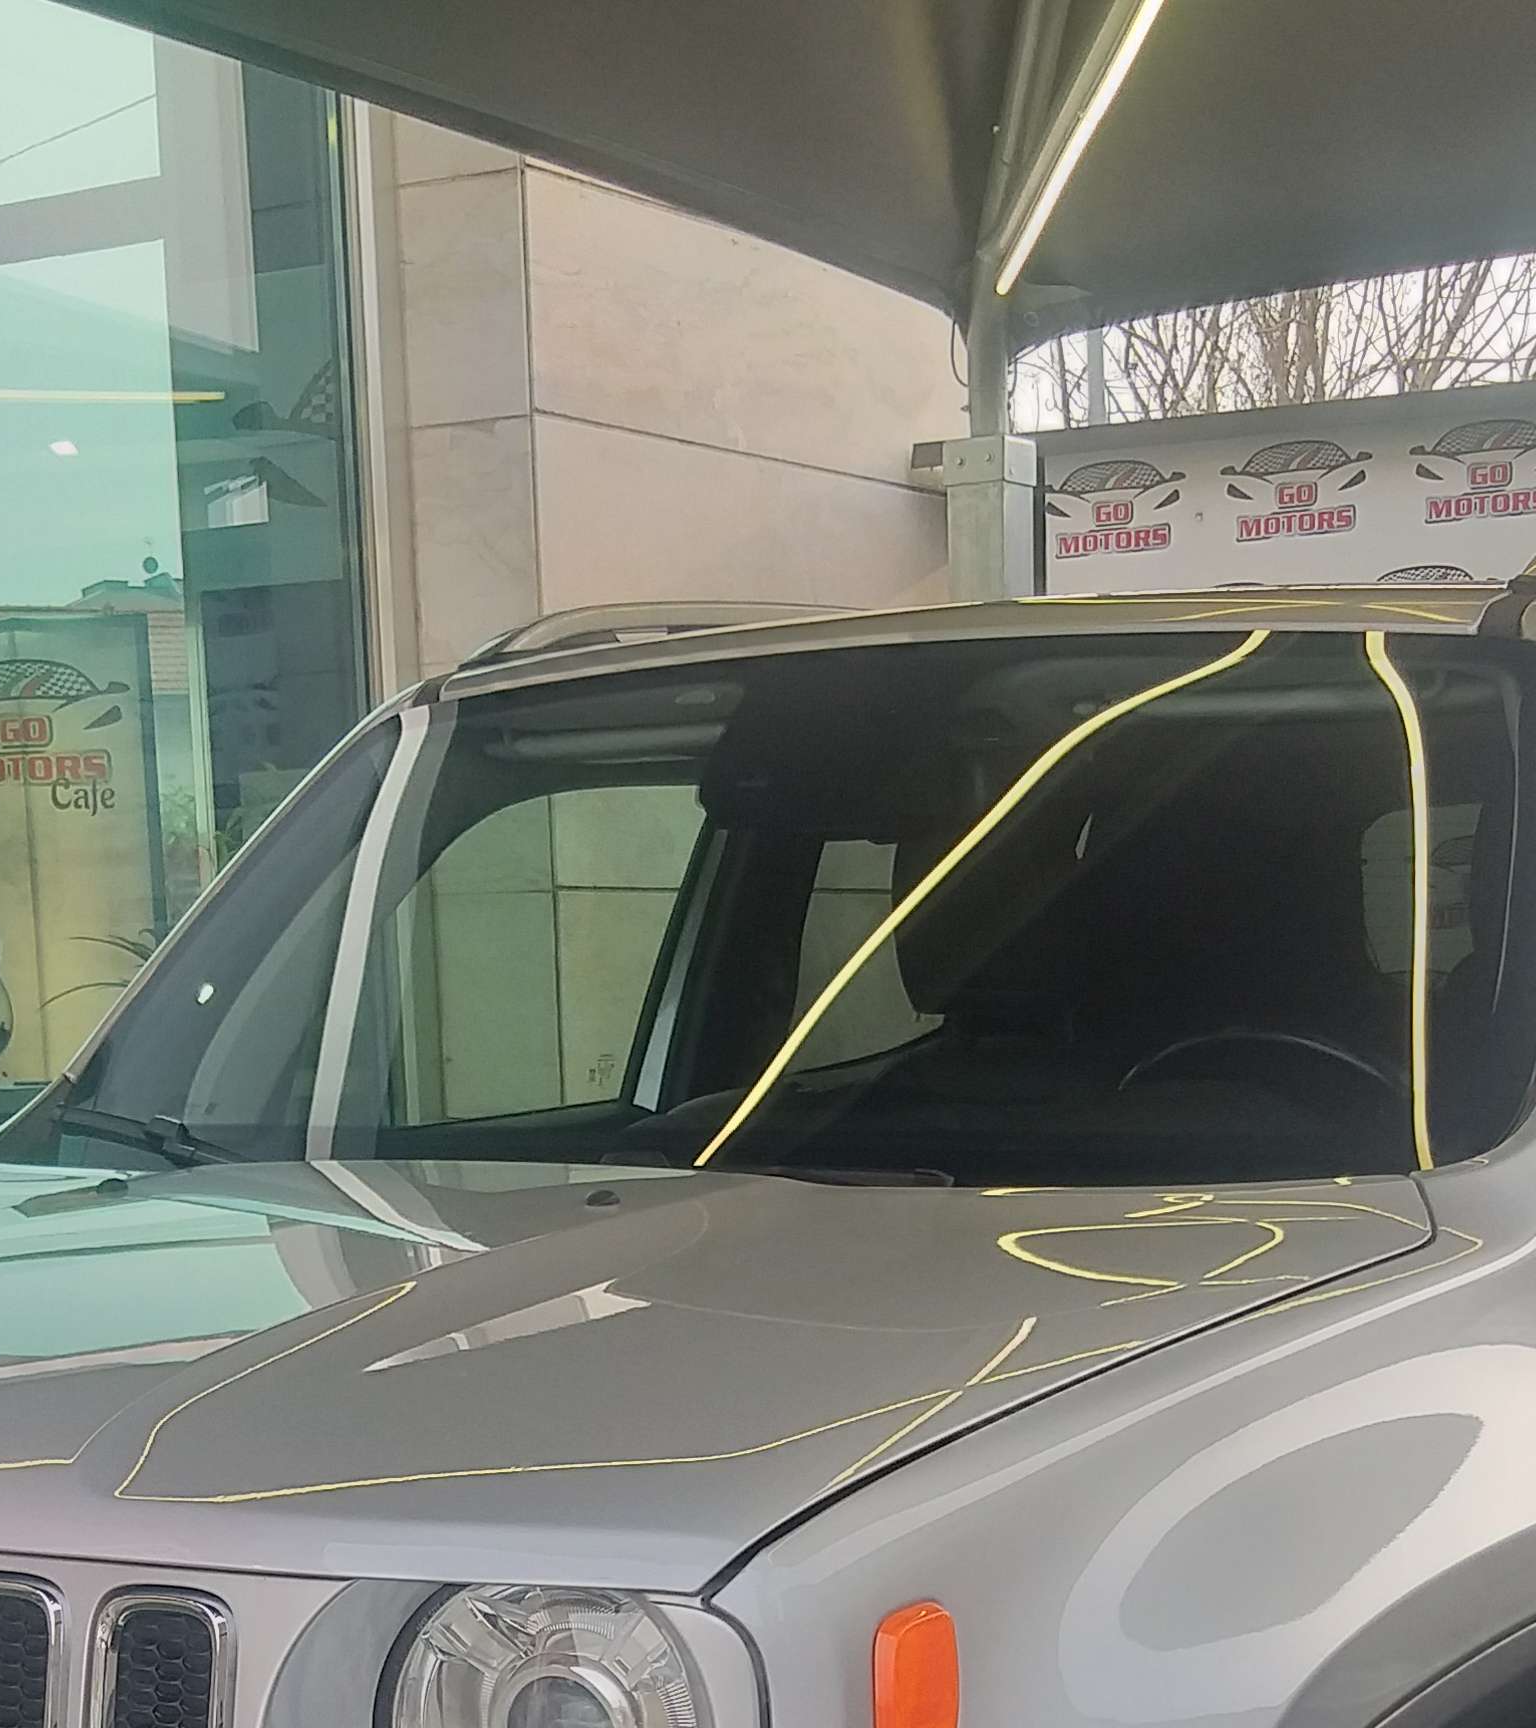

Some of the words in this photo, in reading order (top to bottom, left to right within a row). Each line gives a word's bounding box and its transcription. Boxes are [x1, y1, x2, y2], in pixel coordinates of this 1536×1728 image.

[1469, 462, 1510, 488] GO
[1277, 481, 1316, 506] GO
[1094, 501, 1132, 526] GO
[1238, 505, 1354, 540] MOTORS
[1058, 524, 1170, 557] MOTORS
